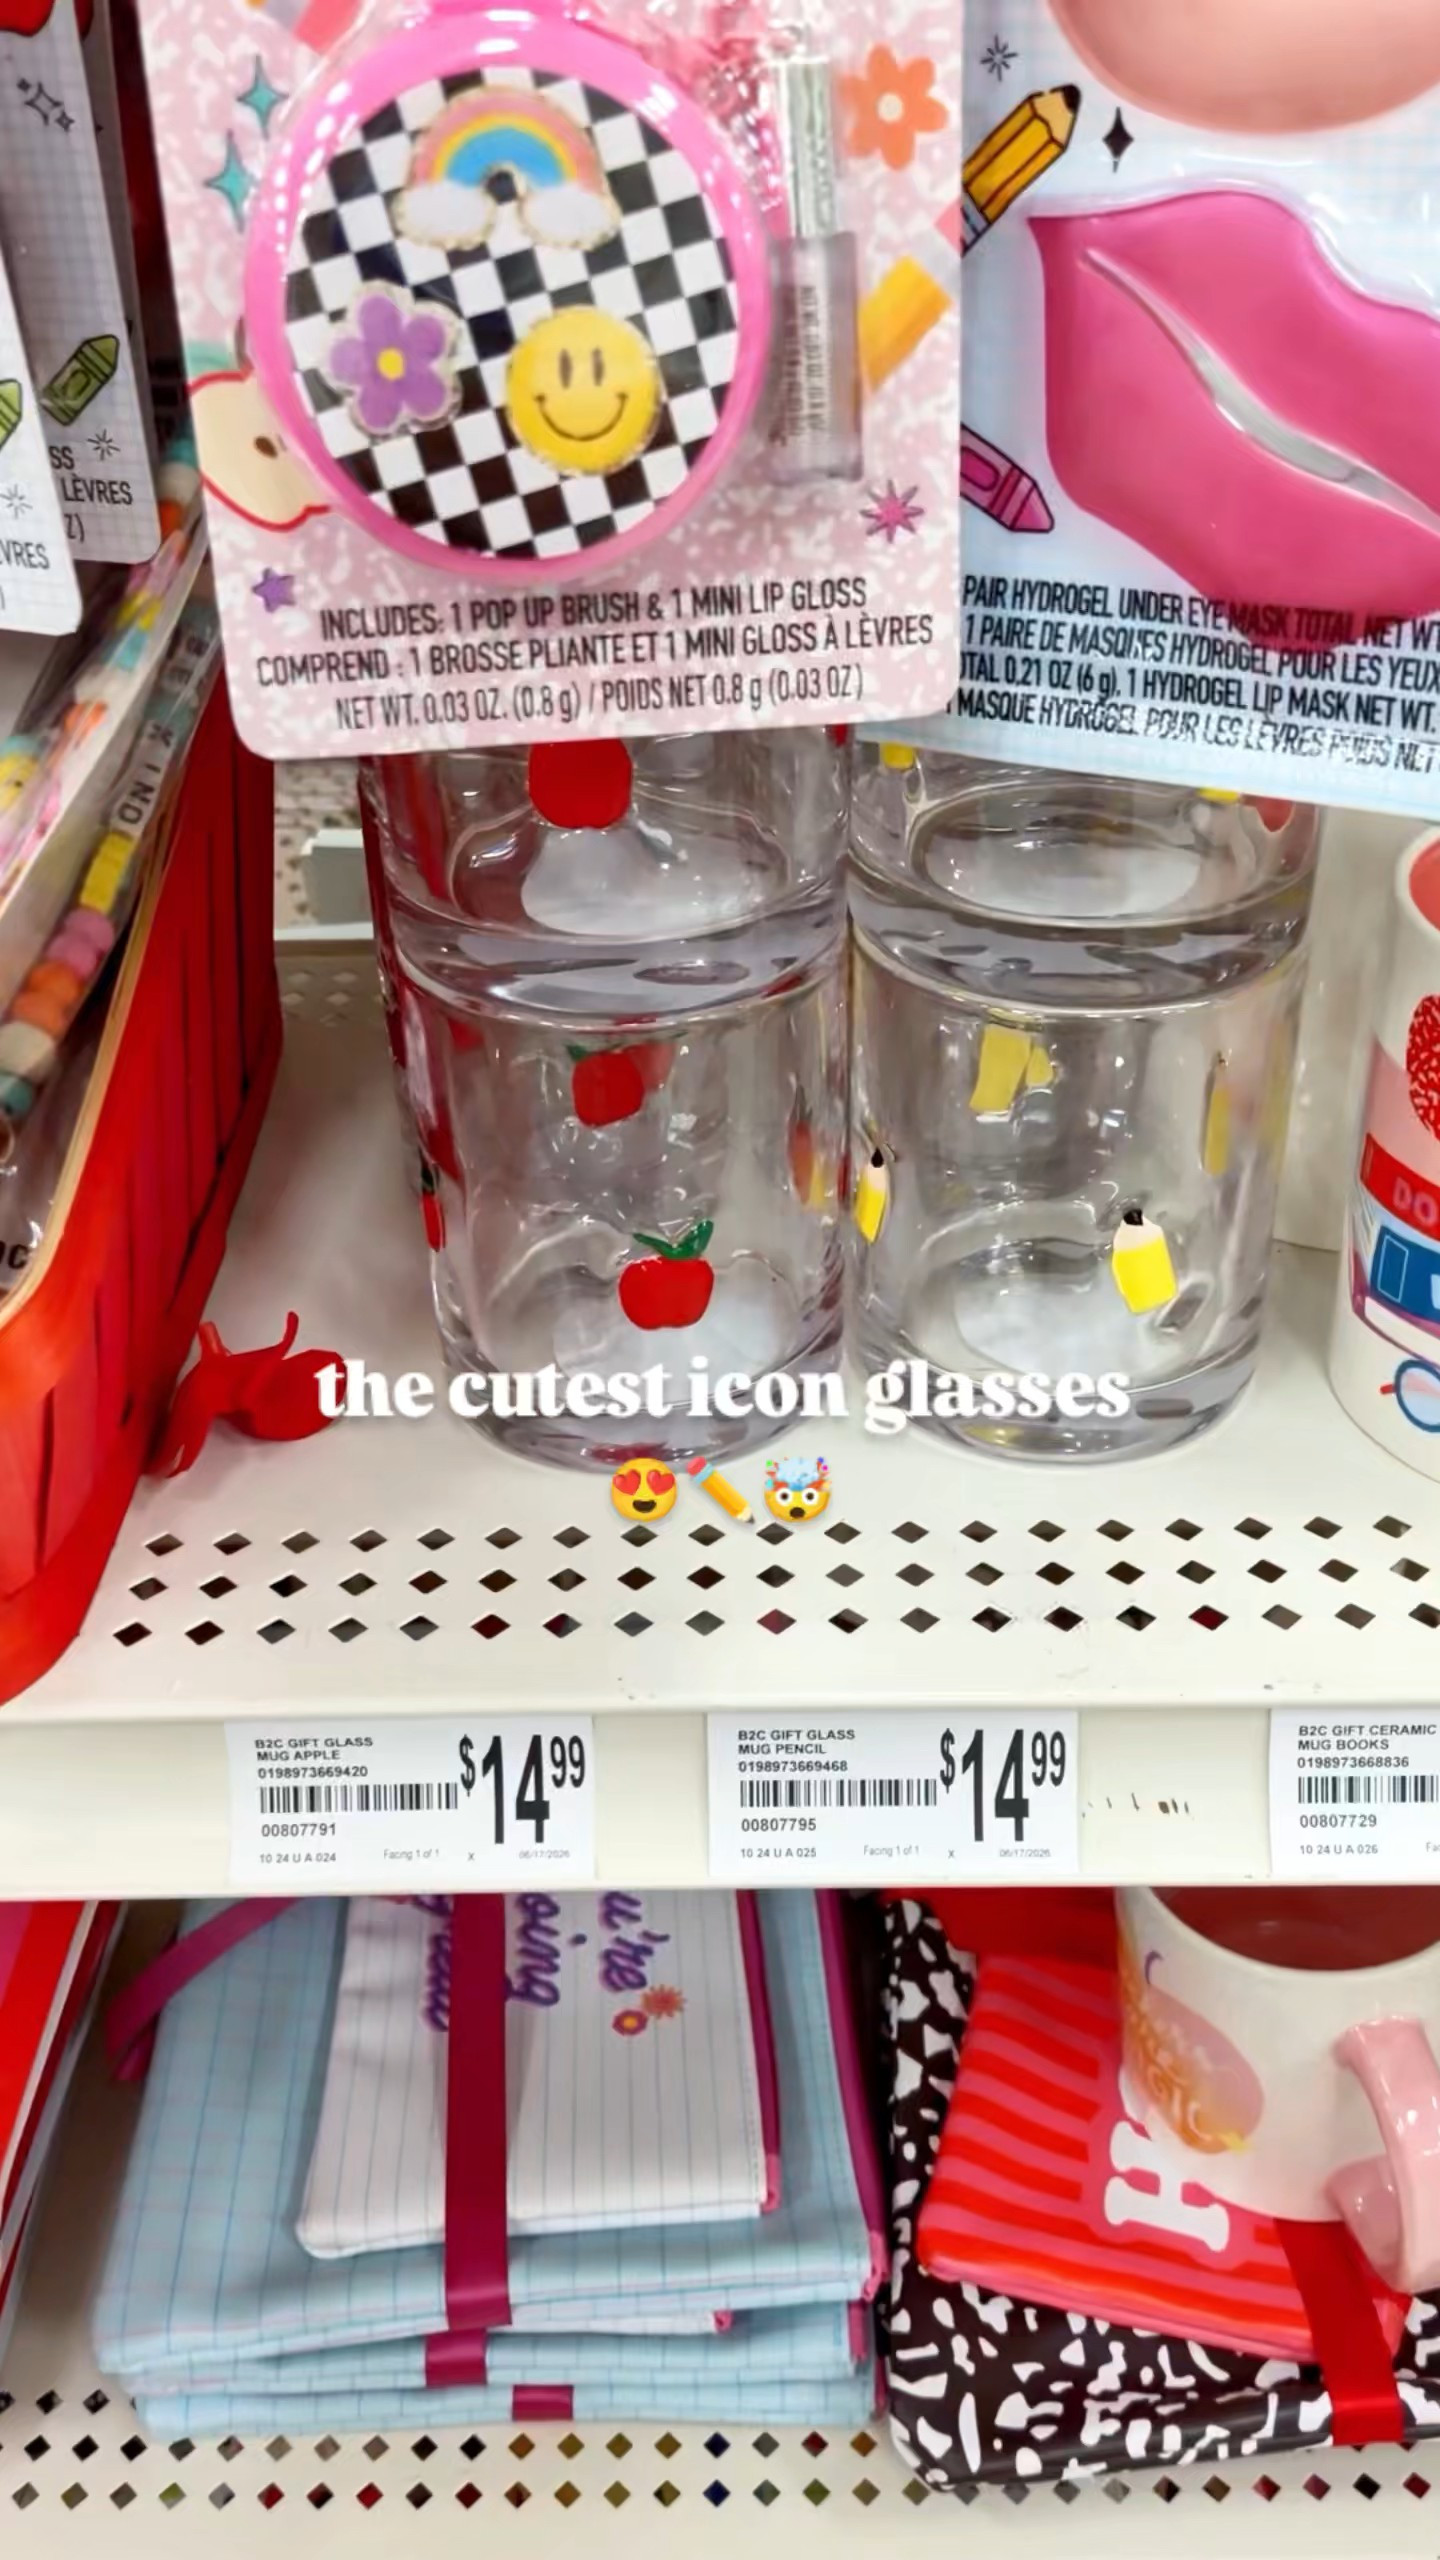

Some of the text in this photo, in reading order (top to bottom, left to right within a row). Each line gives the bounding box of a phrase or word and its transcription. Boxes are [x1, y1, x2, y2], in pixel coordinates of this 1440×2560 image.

[61, 473, 133, 505] LÈVRES
[0, 540, 50, 570] VRES
[320, 577, 866, 641] INCLUDES: 1 POP UP BRUSH & 1 MINI LIP GLOSS
[963, 575, 1008, 610] PAIR
[1013, 578, 1114, 617] HYDROGEL
[1119, 587, 1183, 625] UNDER
[1188, 597, 1224, 631] EYE
[1229, 600, 1289, 638] MASK
[1294, 607, 1357, 645] TOTAL
[1364, 613, 1406, 648] NET
[257, 648, 389, 686] COMPREND
[411, 647, 421, 676] 1
[430, 641, 524, 675] BROSSE
[530, 633, 625, 669] PLIANTE
[633, 632, 658, 663] ET
[666, 631, 675, 661] 1
[686, 627, 736, 661] MINI
[743, 622, 816, 656] GLOSS
[824, 615, 838, 650] À
[846, 612, 933, 649] LÈVRES
[966, 614, 974, 645] 1
[979, 615, 1037, 650] PAIRE
[1039, 621, 1067, 653] DE
[1169, 632, 1271, 677] HYDROGEL
[1278, 650, 1336, 682] POUR
[1341, 652, 1383, 686] LES
[1389, 655, 1440, 694] YEUX
[336, 663, 863, 729] NET WT. 0.03 OZ. (0.8 g) / POIDS NET 0.8 g (0.03 OZ)
[1049, 660, 1074, 690] OZ
[1077, 662, 1094, 695] (6
[1128, 668, 1136, 697] 1
[1143, 669, 1248, 709] HYDROGEL
[1253, 681, 1282, 715] LIP
[1287, 686, 1350, 722] MASK
[1354, 693, 1396, 726] NET
[1400, 700, 1436, 733] WT.
[957, 688, 1036, 724] MASQUE
[1039, 695, 1138, 735] HYDROGEL
[738, 1728, 855, 1741] B2C GIFT GLASS
[1298, 1724, 1437, 1736] B2C GIFT CERAMIC
[255, 1737, 373, 1749] B2C GIFT GLASS
[738, 1743, 827, 1755] MUG PENCIL
[1298, 1739, 1389, 1751] MUG BOOKS
[256, 1749, 341, 1762] MUG APPLE
[1297, 1756, 1409, 1768] 0198973668836
[257, 1766, 368, 1779] 0198973669420
[738, 1760, 848, 1773] 0198973669468
[741, 1818, 817, 1832] 00807795
[1299, 1815, 1377, 1828] 00807729
[261, 1823, 337, 1838] 00807791
[259, 1853, 273, 1864] 10
[276, 1853, 290, 1864] 24
[292, 1853, 302, 1864] U
[304, 1853, 313, 1863] A
[315, 1852, 337, 1863] 024
[383, 1848, 413, 1861] Facing
[740, 1848, 753, 1858] 10
[757, 1848, 770, 1858] 24
[773, 1848, 782, 1858] U
[785, 1848, 794, 1858] A
[796, 1848, 817, 1858] 025
[863, 1845, 893, 1857] Facing
[1299, 1844, 1313, 1855] 10
[1317, 1844, 1331, 1855] 24
[1334, 1844, 1343, 1854] U
[1345, 1844, 1354, 1854] A
[1357, 1844, 1378, 1854] 026
